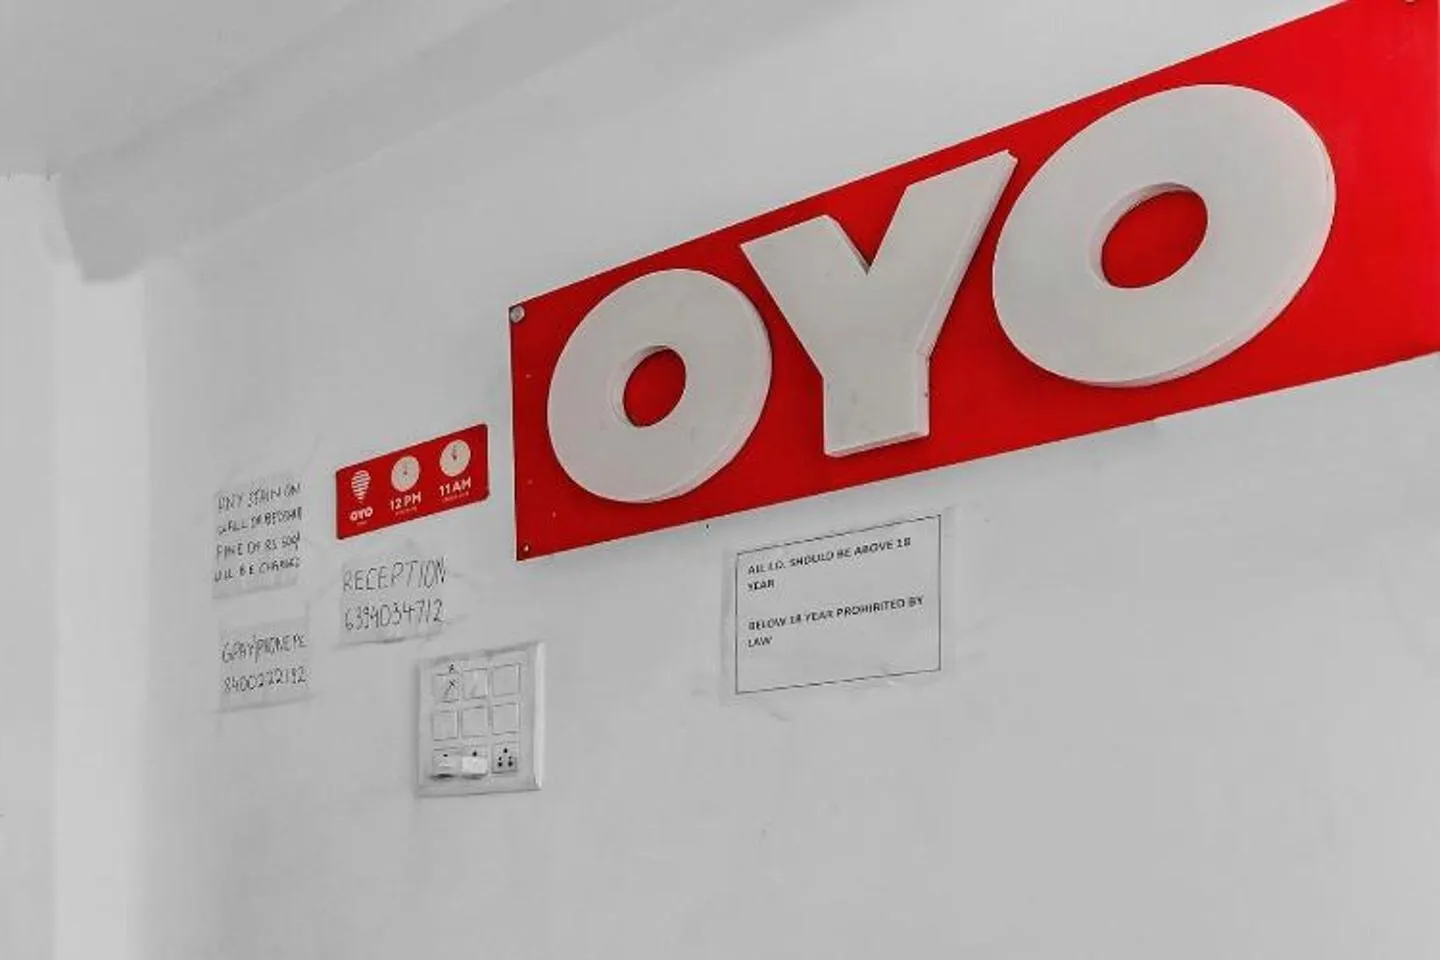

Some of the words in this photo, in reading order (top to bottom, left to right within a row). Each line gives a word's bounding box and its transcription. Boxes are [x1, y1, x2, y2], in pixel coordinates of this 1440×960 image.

[547, 83, 1337, 503] OYO
[349, 506, 373, 521] OYO
[342, 556, 448, 592] RECEPTION
[748, 564, 766, 576] ALL
[789, 551, 834, 567] SHOULD
[836, 548, 852, 559] BE
[854, 540, 894, 557] ABOVE
[747, 579, 775, 592] YEAR
[748, 617, 787, 632] BELOW
[805, 609, 834, 623] YEAR
[836, 598, 906, 619] PROHIBITED
[908, 595, 925, 607] BY
[747, 636, 773, 648] LAW
